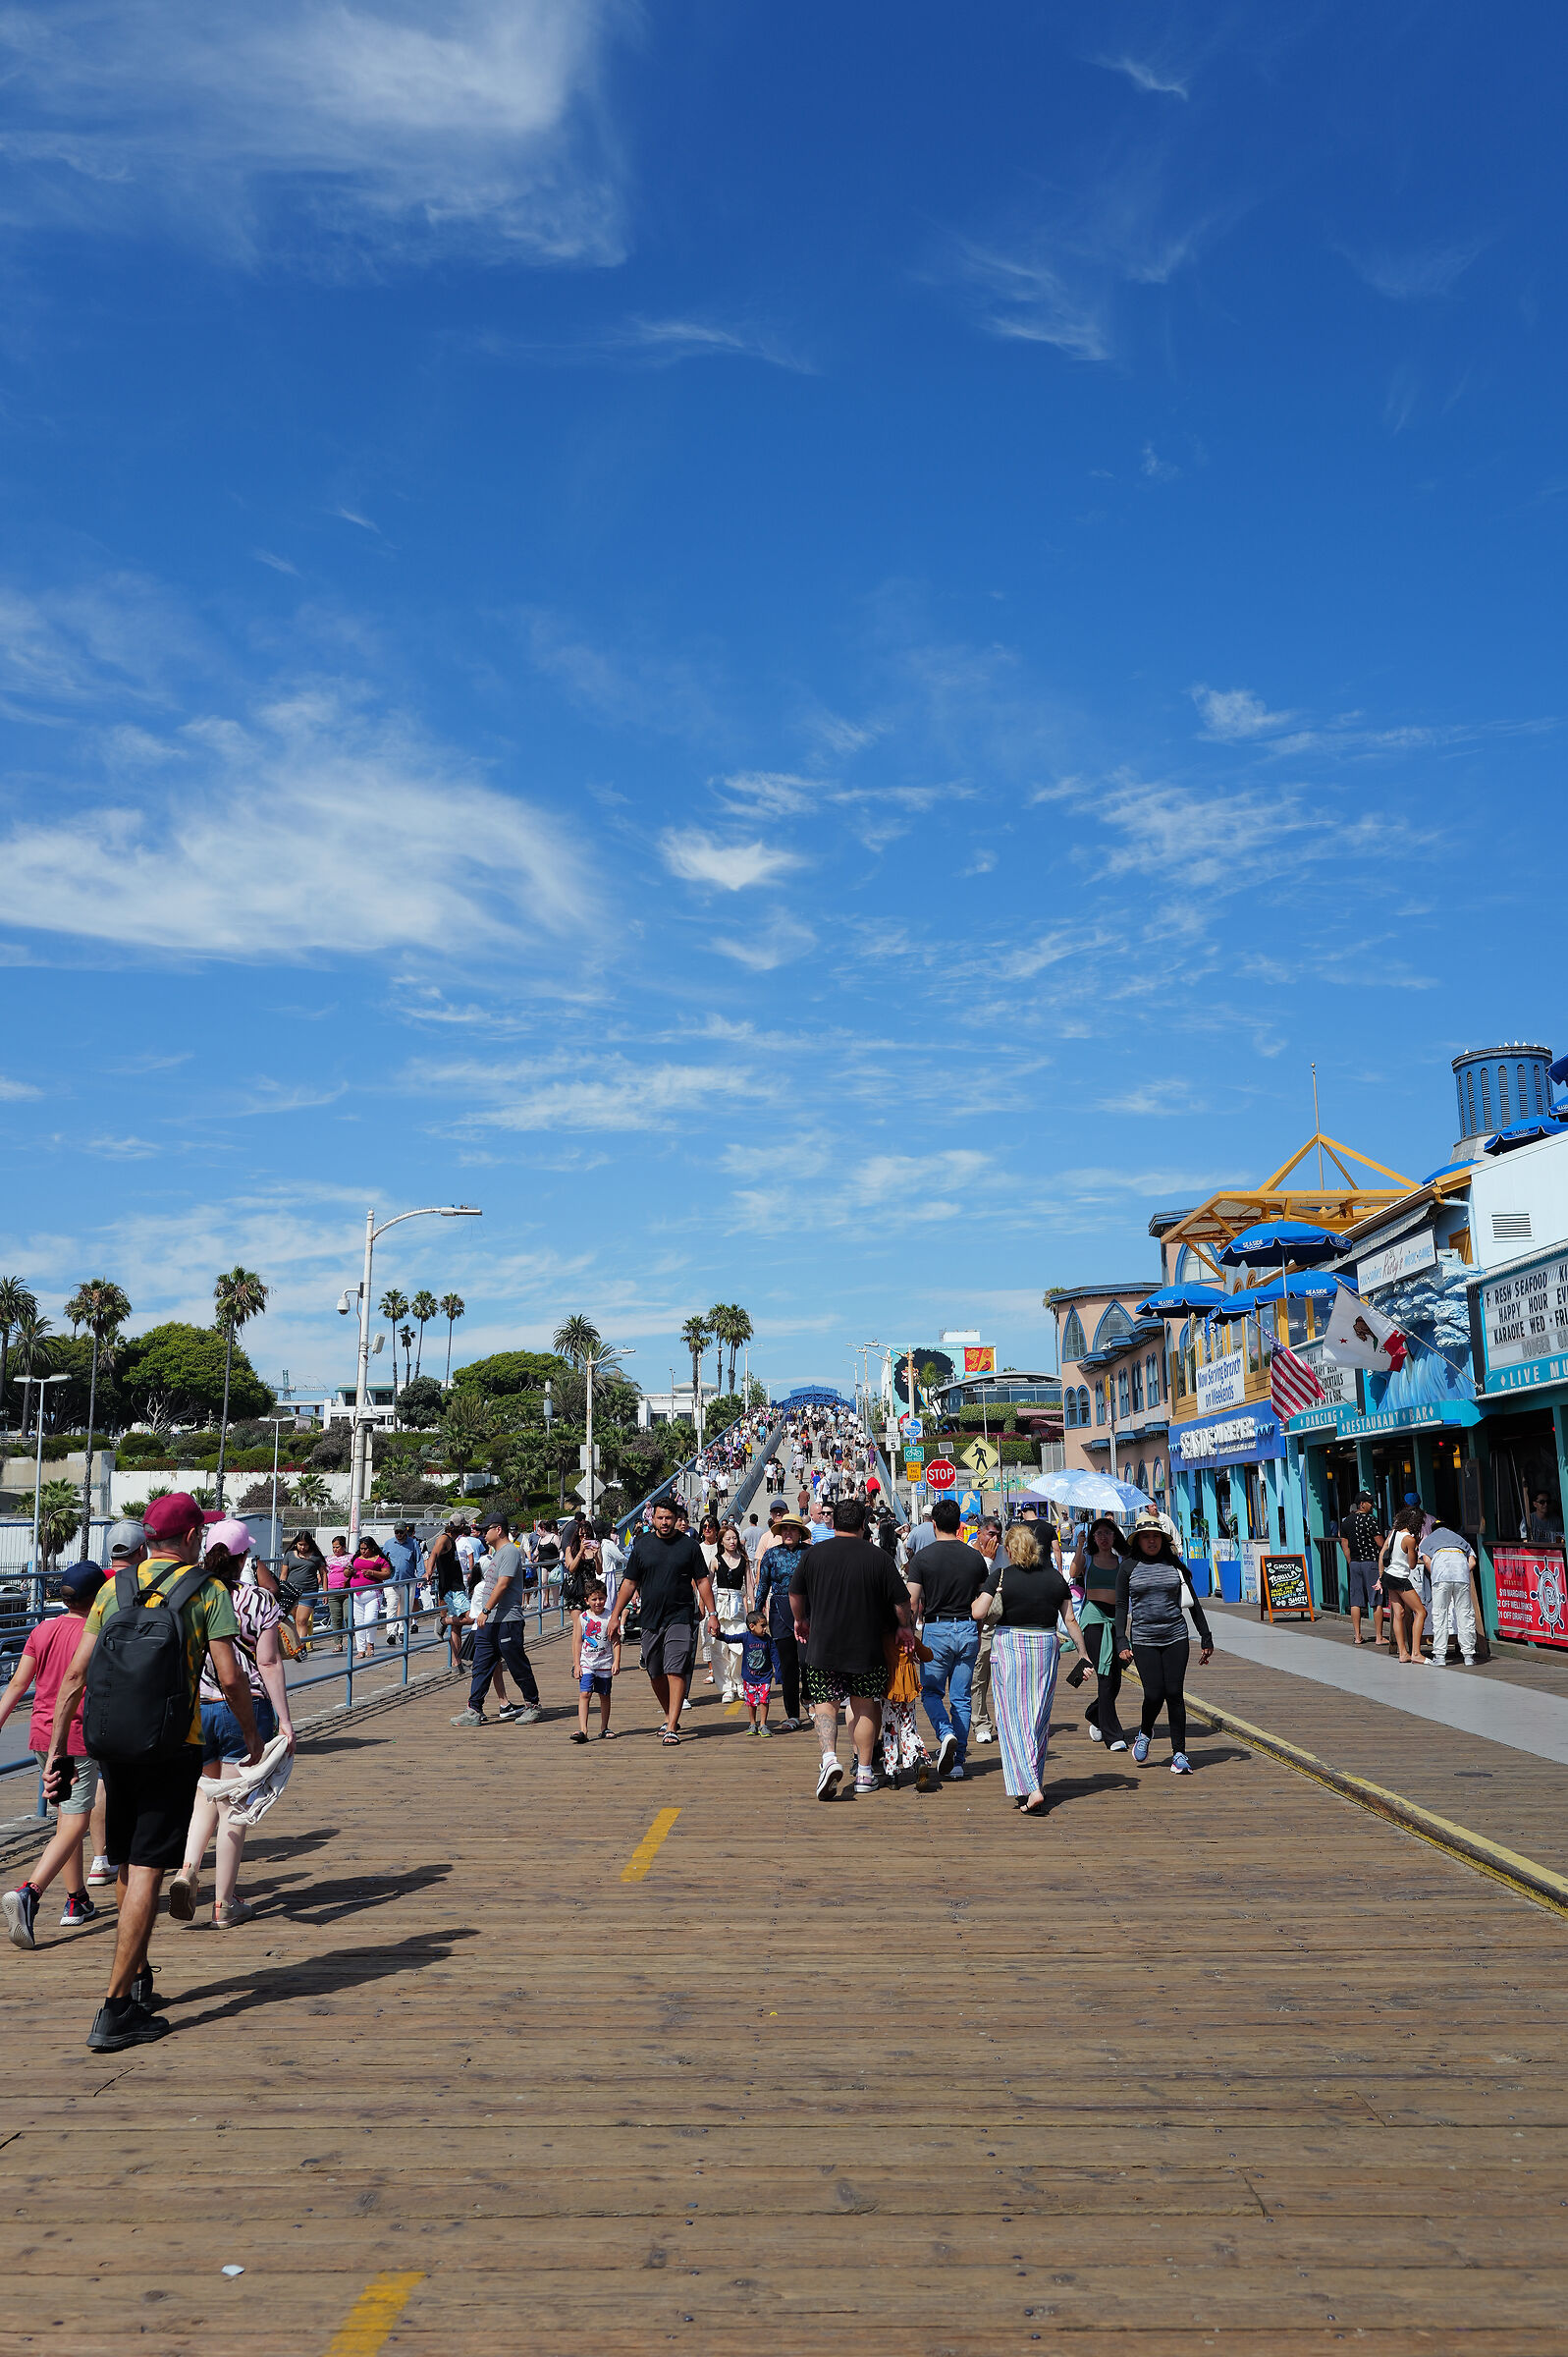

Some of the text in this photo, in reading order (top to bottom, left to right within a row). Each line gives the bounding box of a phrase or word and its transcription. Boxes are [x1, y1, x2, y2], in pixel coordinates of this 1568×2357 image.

[1514, 1272, 1547, 1298] SEAFOOD
[1498, 1300, 1521, 1324] HAPPY
[1528, 1292, 1548, 1314] HOUR
[1493, 1321, 1525, 1345] KARAOKE
[1529, 1315, 1545, 1335] WED
[1209, 1366, 1223, 1385] Serving
[1322, 1373, 1343, 1390] COCKTAILS
[1509, 1366, 1541, 1387] LIVE
[1206, 1381, 1234, 1407] on Weekends
[1306, 1410, 1336, 1427] DANCING
[1347, 1406, 1429, 1433] RESTAURANT BAR
[928, 1468, 954, 1481] STOP
